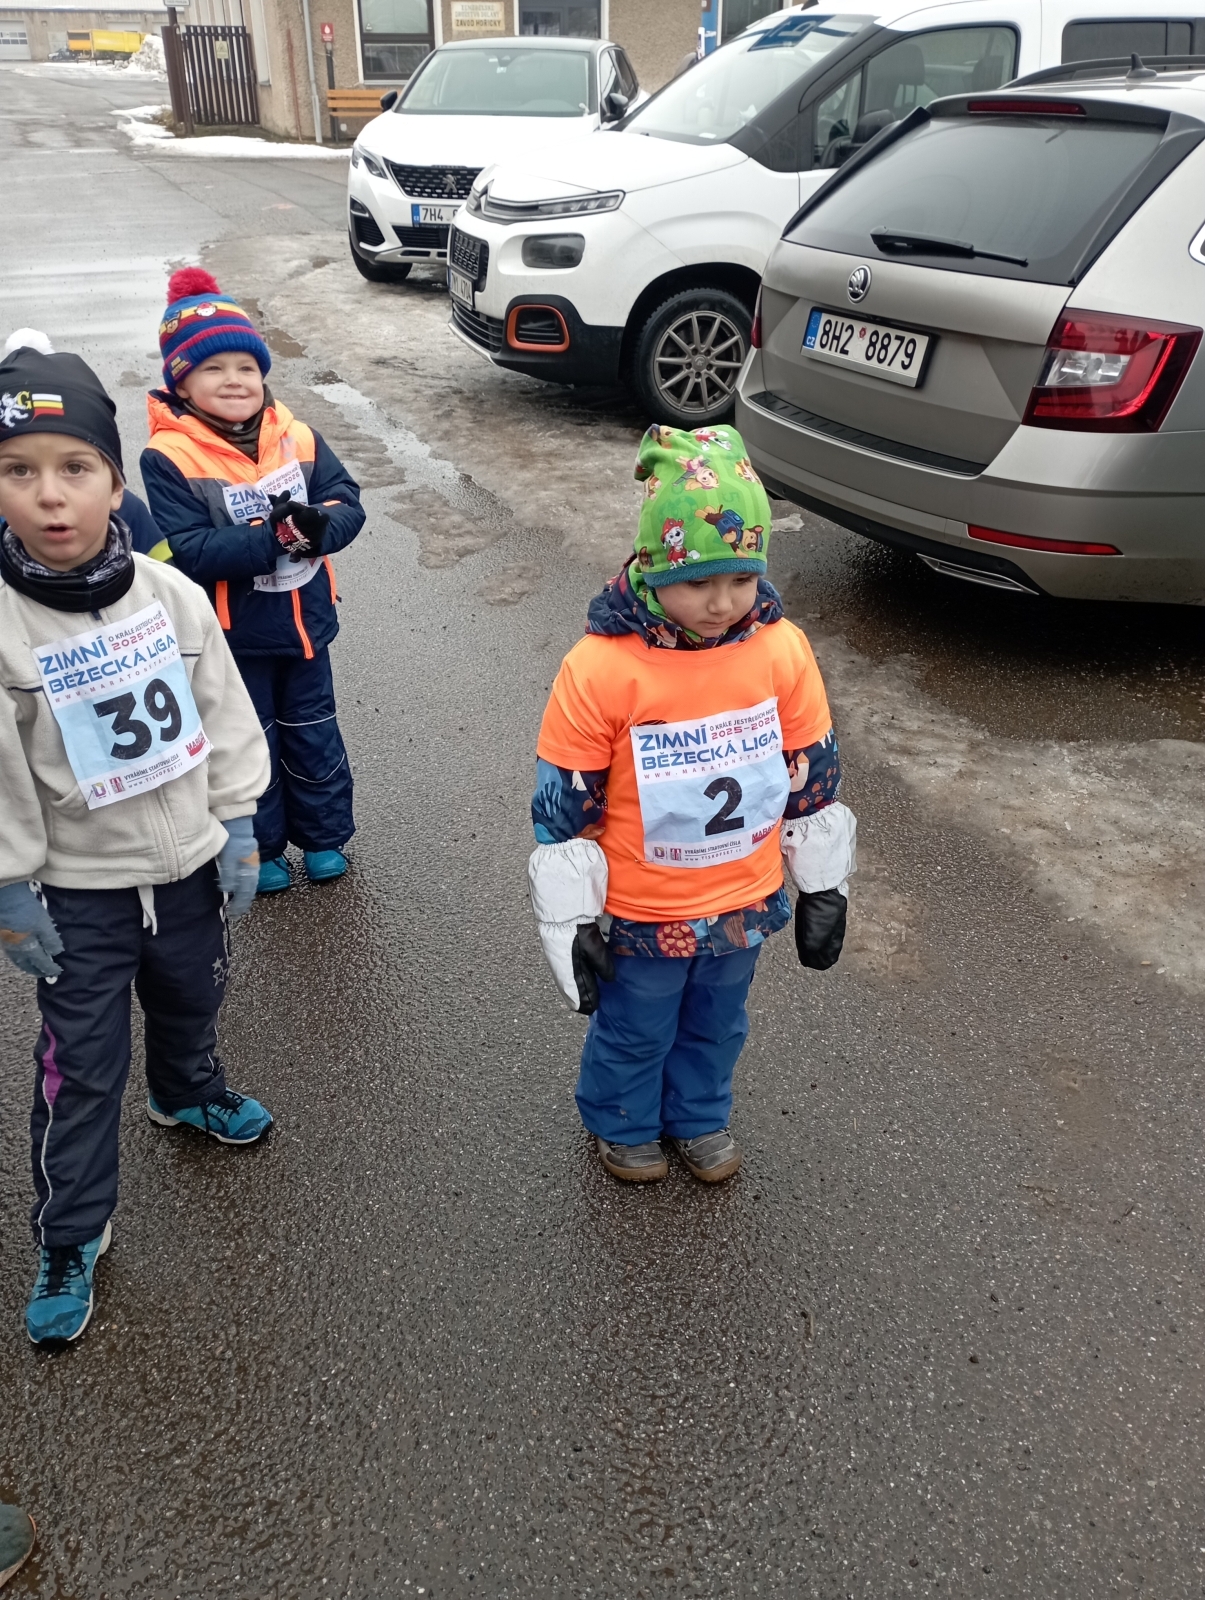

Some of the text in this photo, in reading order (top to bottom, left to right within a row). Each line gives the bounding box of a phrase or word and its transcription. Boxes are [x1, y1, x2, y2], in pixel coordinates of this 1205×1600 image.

[422, 207, 443, 222] 7H4
[805, 336, 815, 346] CZ
[819, 319, 917, 371] 8H2 8879
[111, 618, 167, 651] 2025-2026
[114, 627, 135, 642] KRÁLE
[39, 635, 108, 676] ZIMNÍ
[48, 634, 177, 695] BĚŽECKÁ LIGA
[92, 678, 182, 761] 39
[711, 713, 776, 740] 2025-2026
[714, 719, 733, 732] KRÁLE
[638, 724, 708, 752] ZIMNÍ
[641, 729, 779, 770] BĚŽECKÁ LIGA
[703, 776, 745, 837] 2
